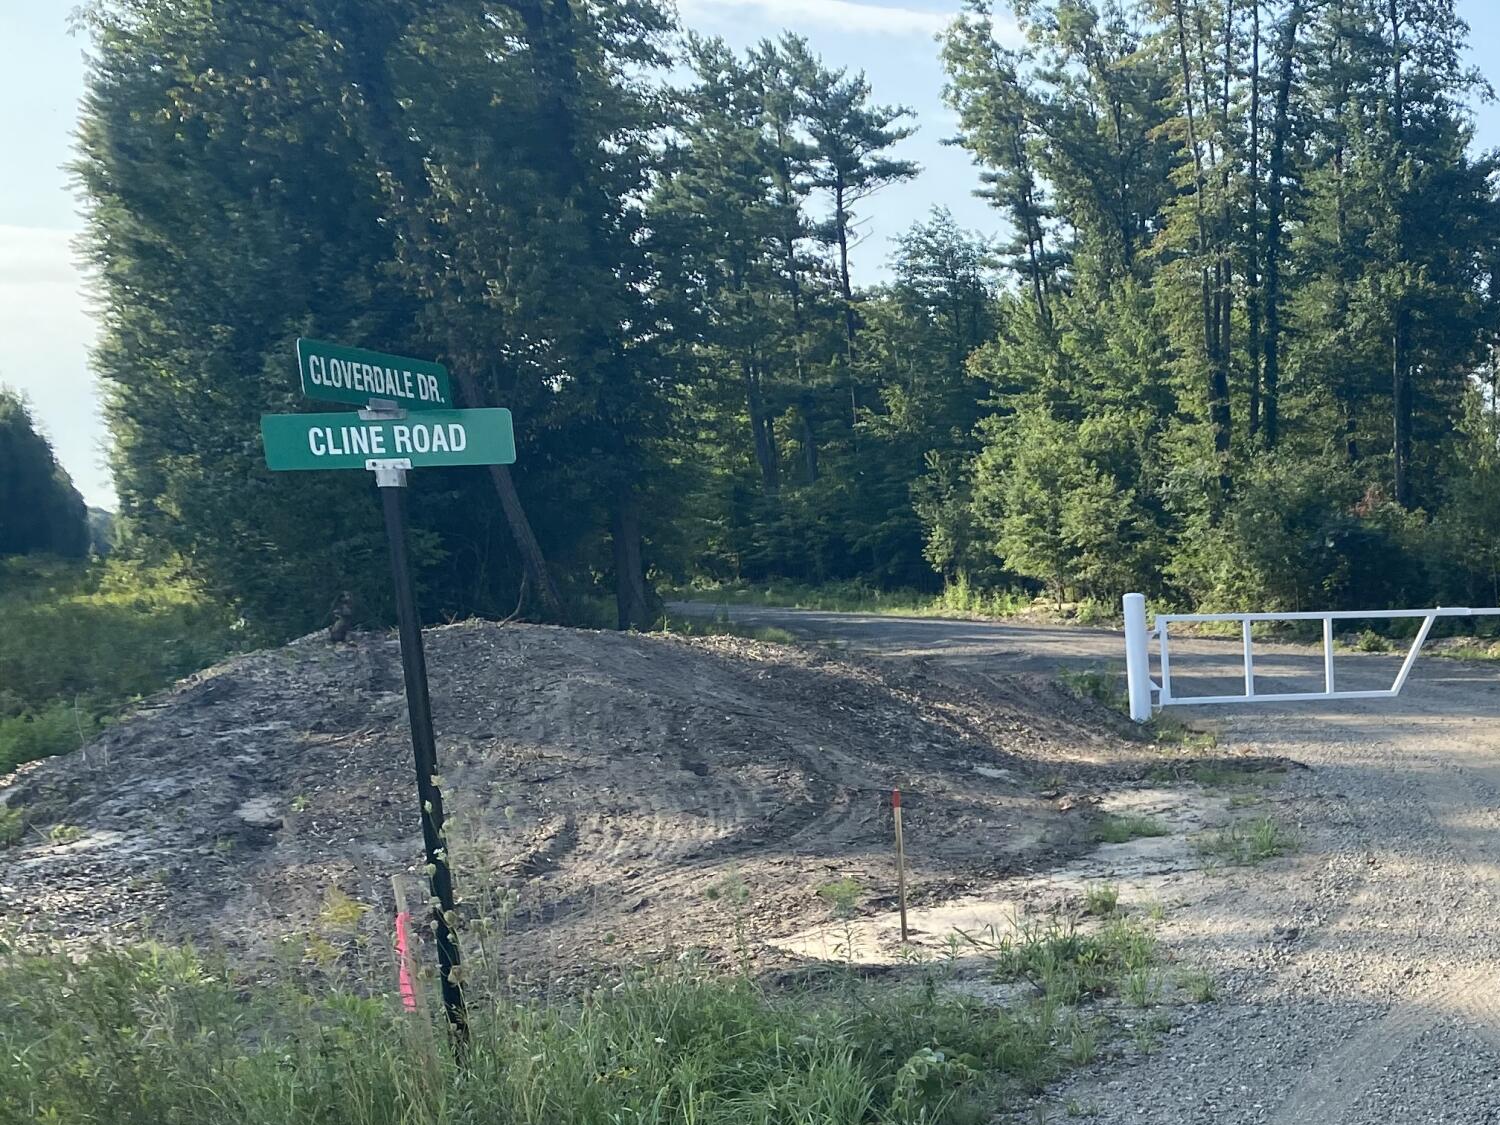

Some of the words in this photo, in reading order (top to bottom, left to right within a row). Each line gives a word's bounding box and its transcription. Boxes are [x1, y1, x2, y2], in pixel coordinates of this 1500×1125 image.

[309, 354, 415, 399] CLOVERDALE
[417, 373, 445, 404] DR.
[308, 425, 386, 456] CLINE
[393, 423, 467, 454] ROAD
